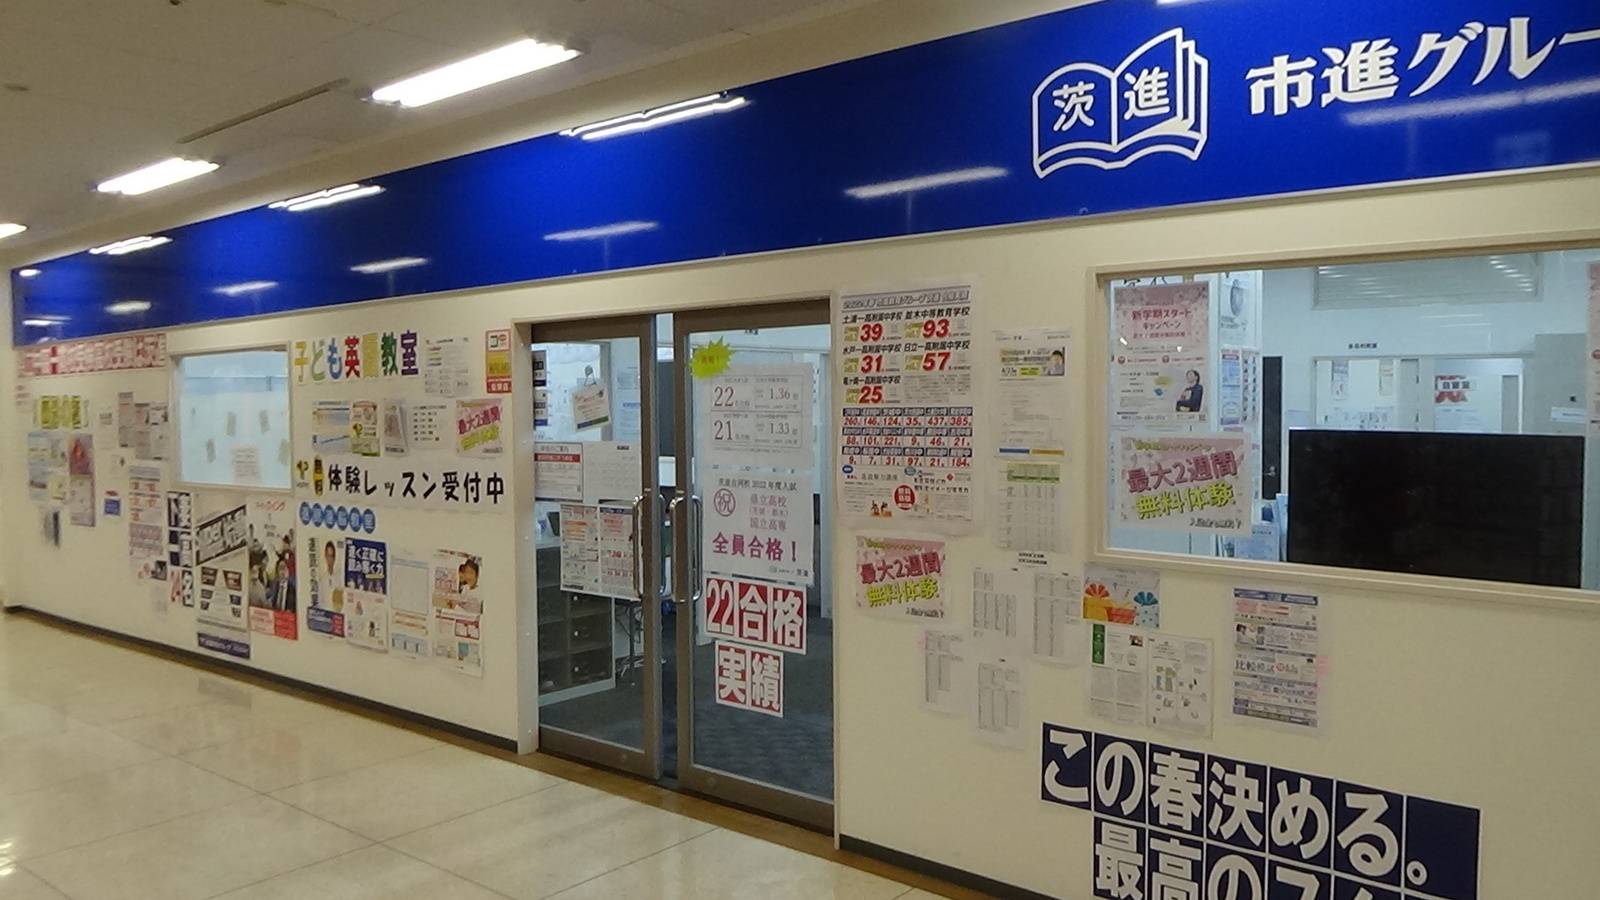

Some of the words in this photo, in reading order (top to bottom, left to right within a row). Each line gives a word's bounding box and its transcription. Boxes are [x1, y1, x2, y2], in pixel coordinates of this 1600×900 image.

[1246, 17, 1600, 116] 市進グルー
[1052, 66, 1171, 132] 茨進
[860, 323, 883, 342] 39
[922, 319, 950, 338] 93
[294, 329, 419, 383] 子ども英教室
[861, 355, 883, 373] 31
[922, 352, 951, 371] 57
[714, 386, 735, 407] 22
[859, 385, 883, 404] 25
[714, 420, 733, 440] 21
[328, 463, 504, 504] 体験レッスン受付中
[1127, 450, 1238, 494] 最大2週間
[1136, 480, 1236, 521] 無料体験
[861, 551, 942, 585] 最大2週間
[707, 578, 804, 648] 22合格
[719, 648, 780, 711] 実績
[1043, 729, 1429, 886] この春決める。
[1095, 821, 1374, 900] 最高の
